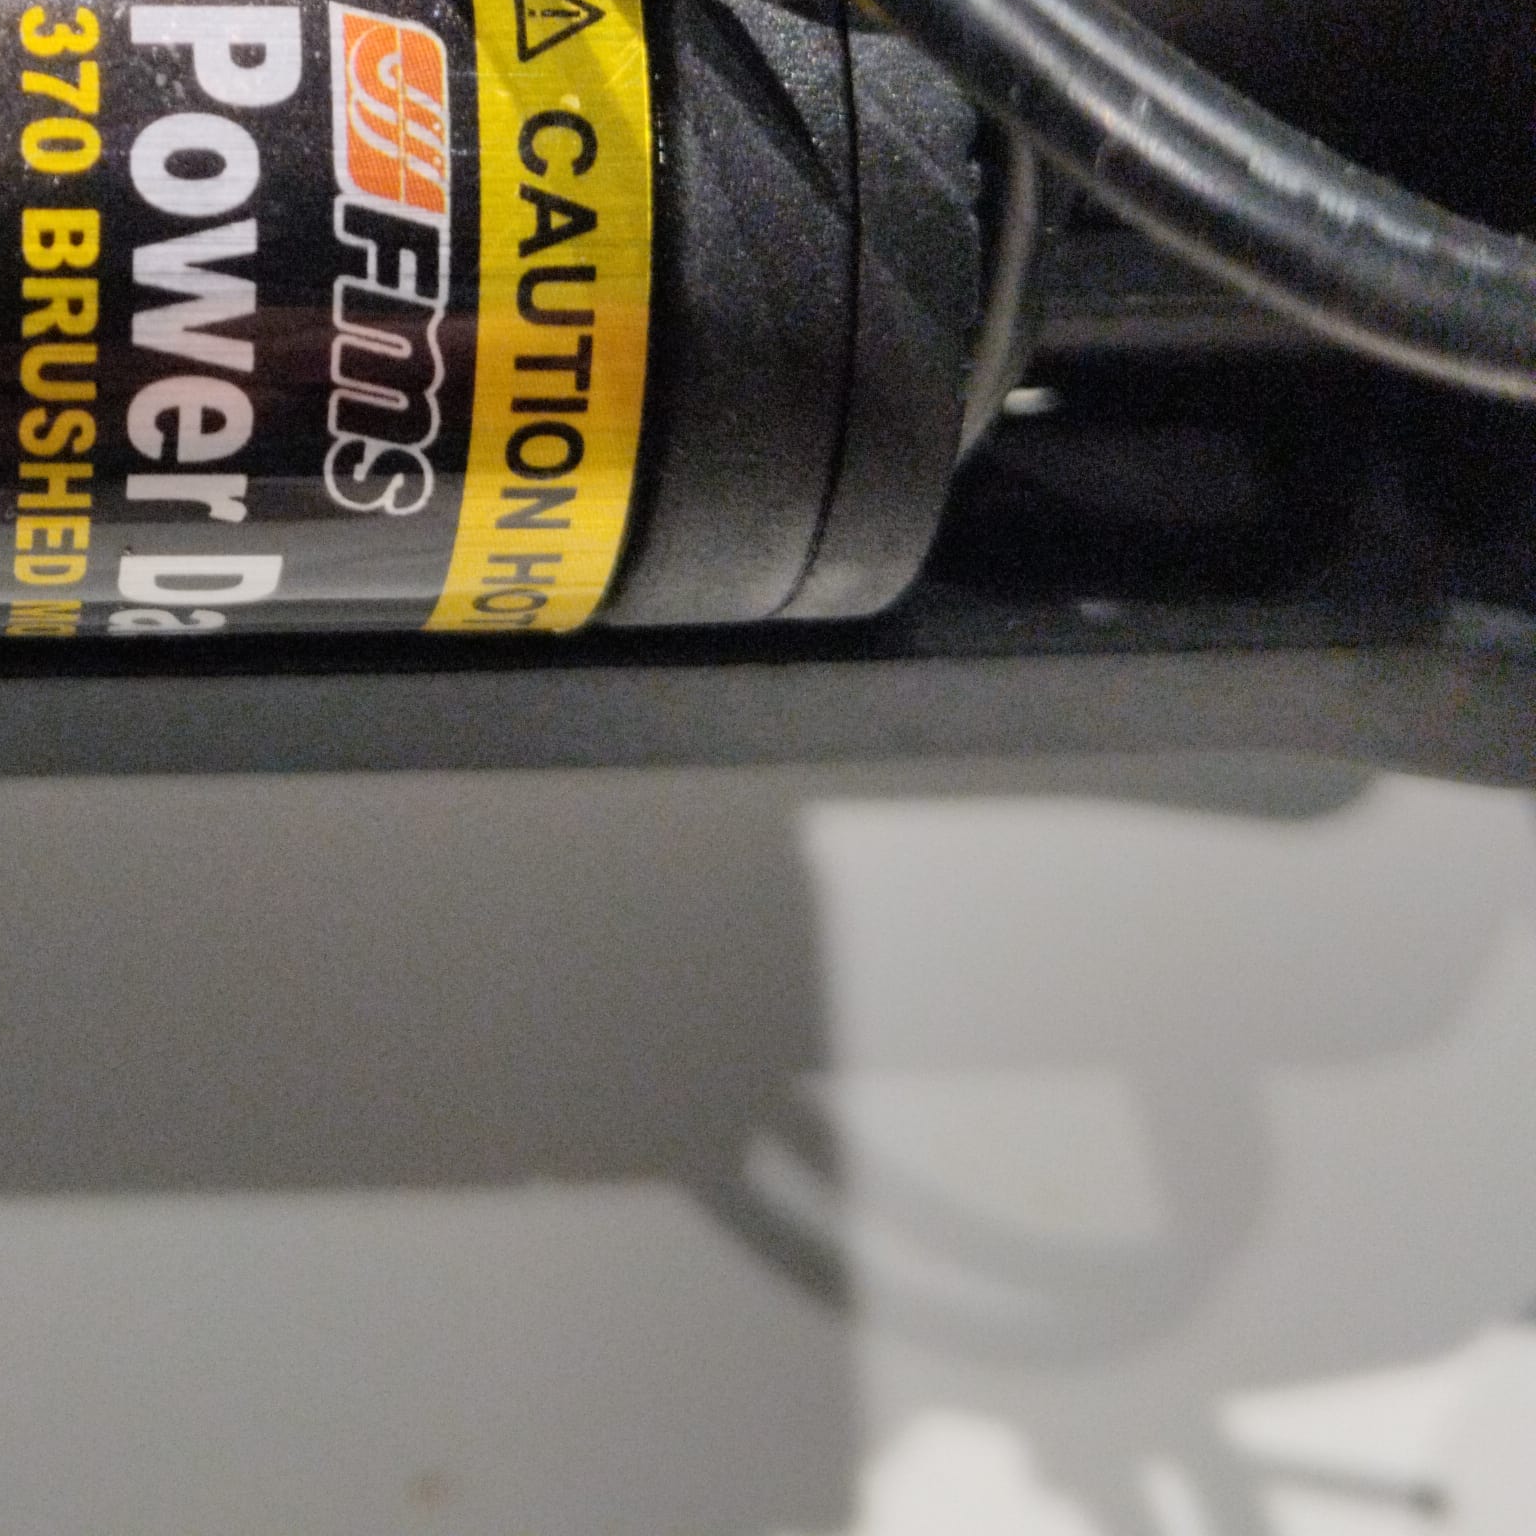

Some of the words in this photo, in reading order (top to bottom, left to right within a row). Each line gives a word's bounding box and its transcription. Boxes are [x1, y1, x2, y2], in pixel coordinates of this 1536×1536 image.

[19, 5, 102, 174] 370
[126, 5, 303, 524] Power
[13, 208, 102, 586] BRUSHED
[494, 108, 600, 531] CAUTION
